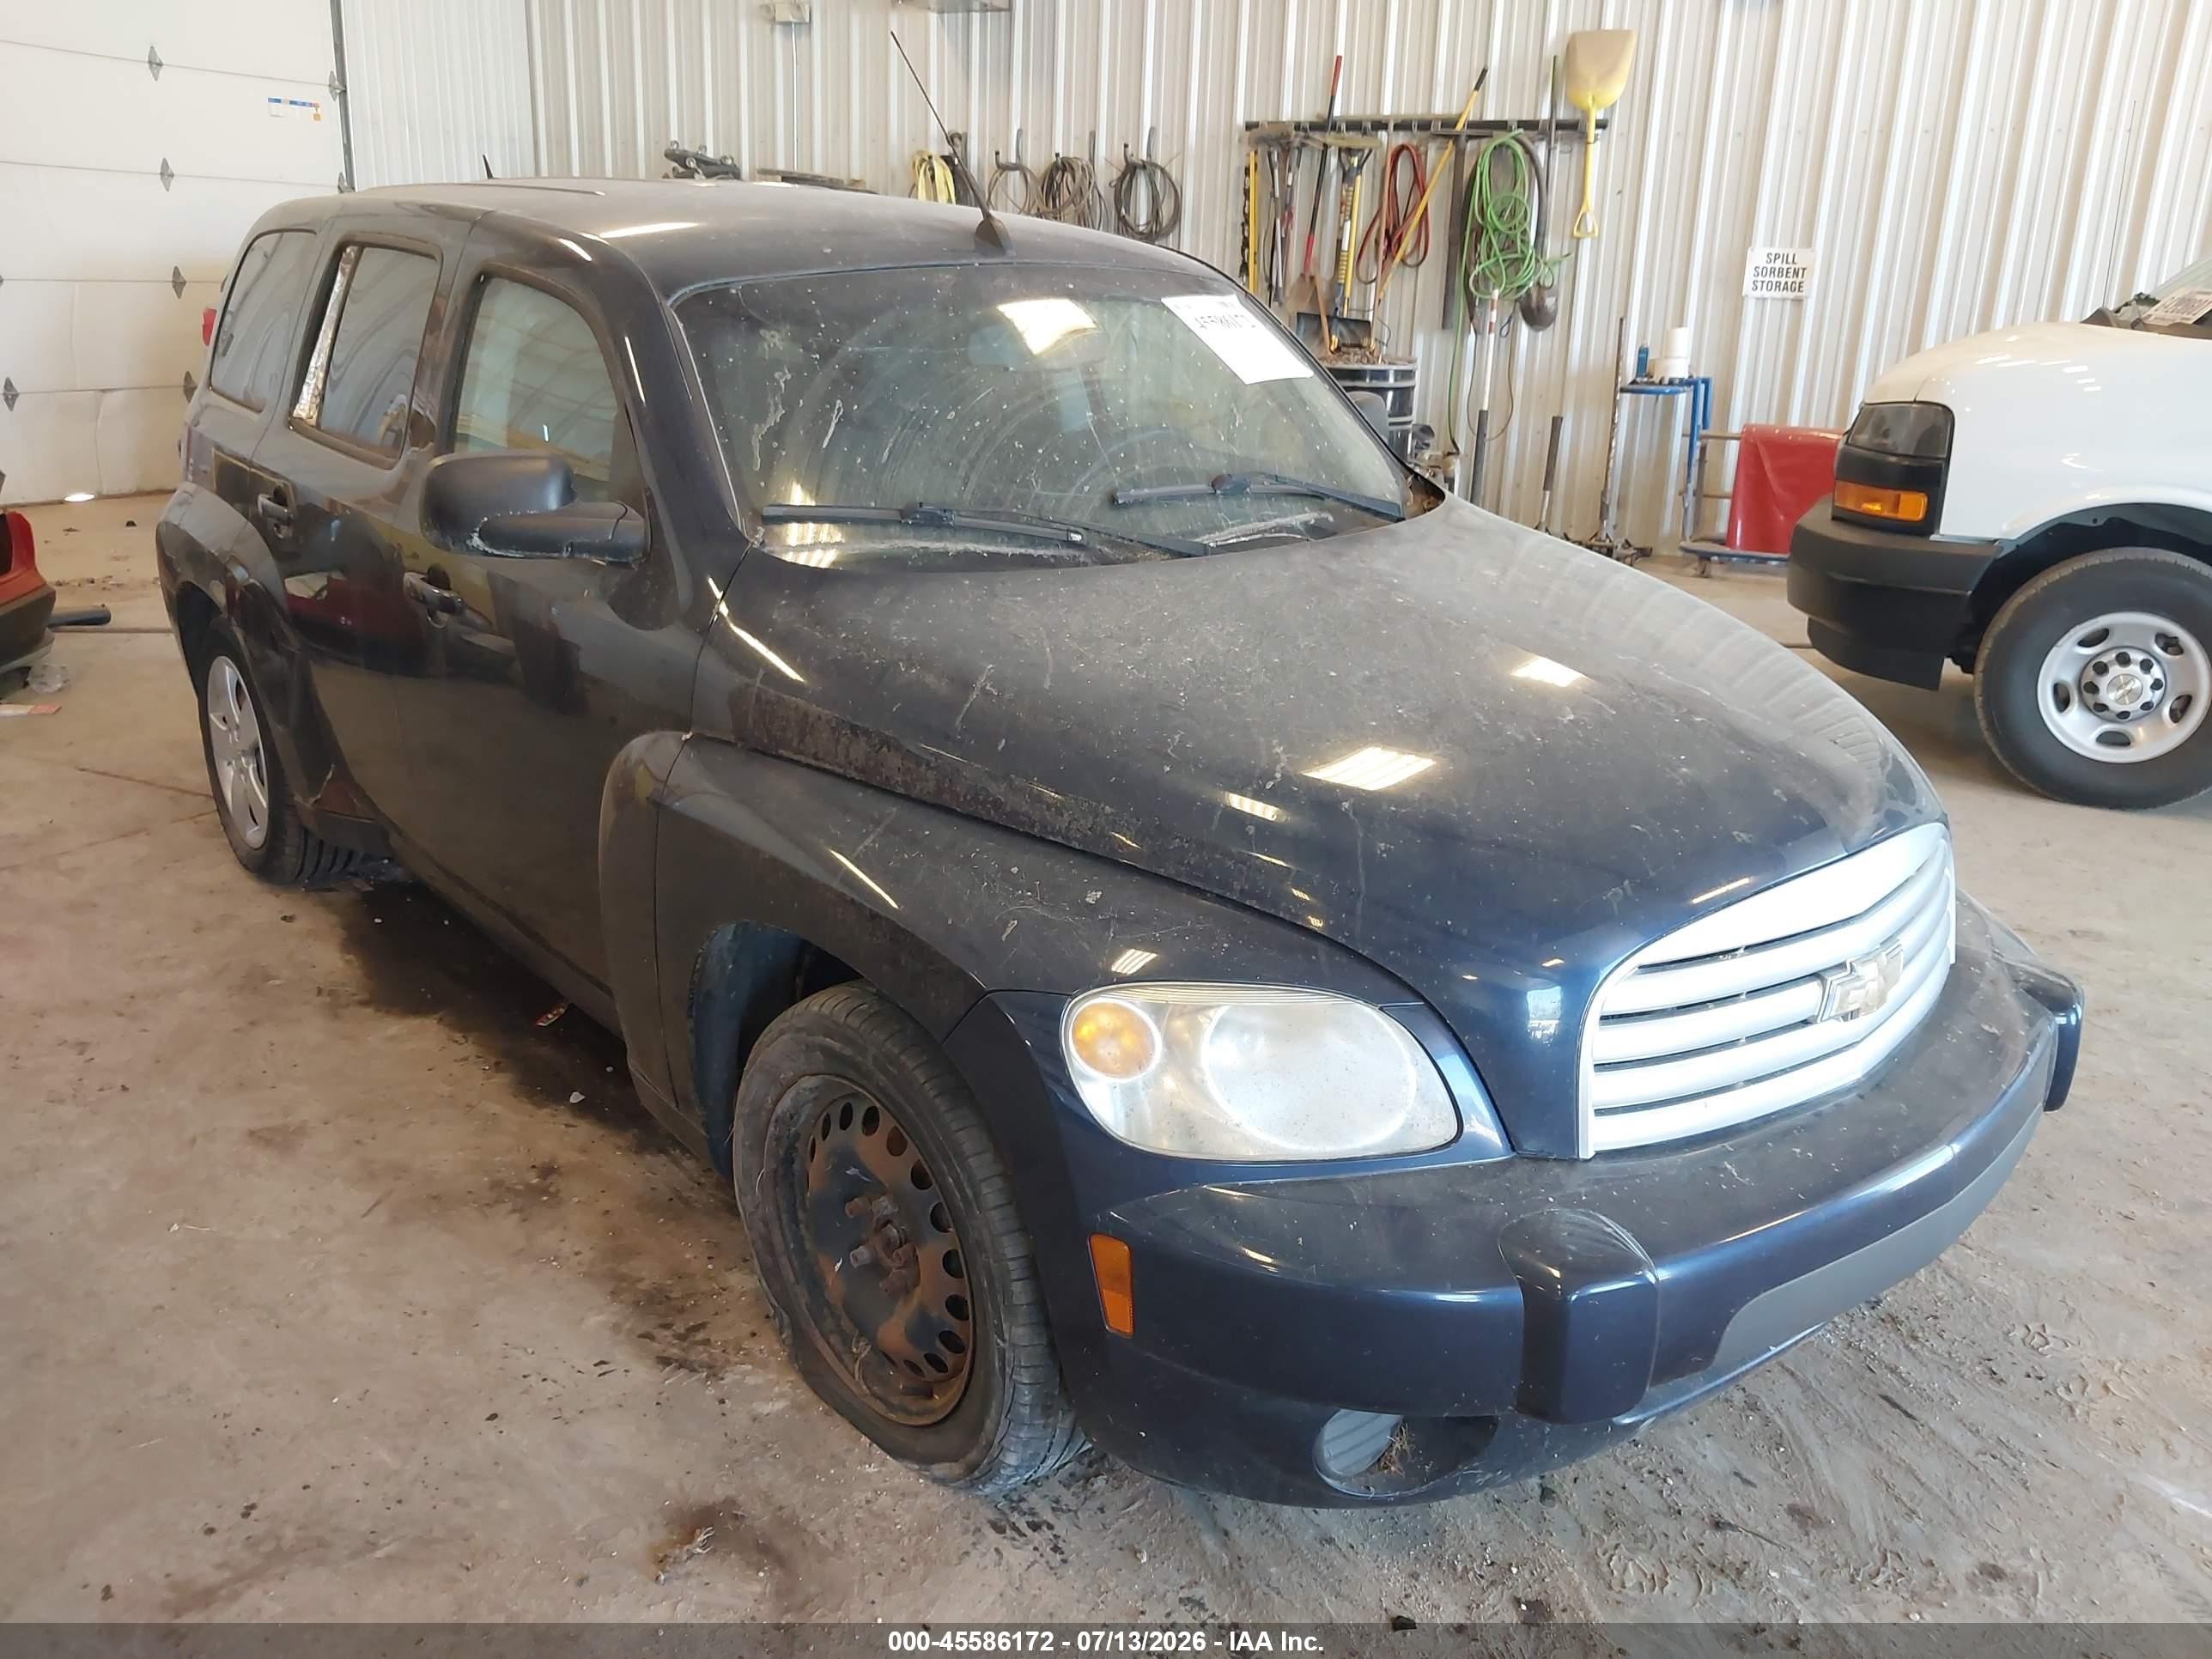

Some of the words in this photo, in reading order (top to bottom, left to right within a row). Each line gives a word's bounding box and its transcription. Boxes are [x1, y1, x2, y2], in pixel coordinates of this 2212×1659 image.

[1765, 252, 1797, 264] SPILL
[1753, 266, 1807, 279] SORBENT
[1752, 280, 1804, 293] STORAGE
